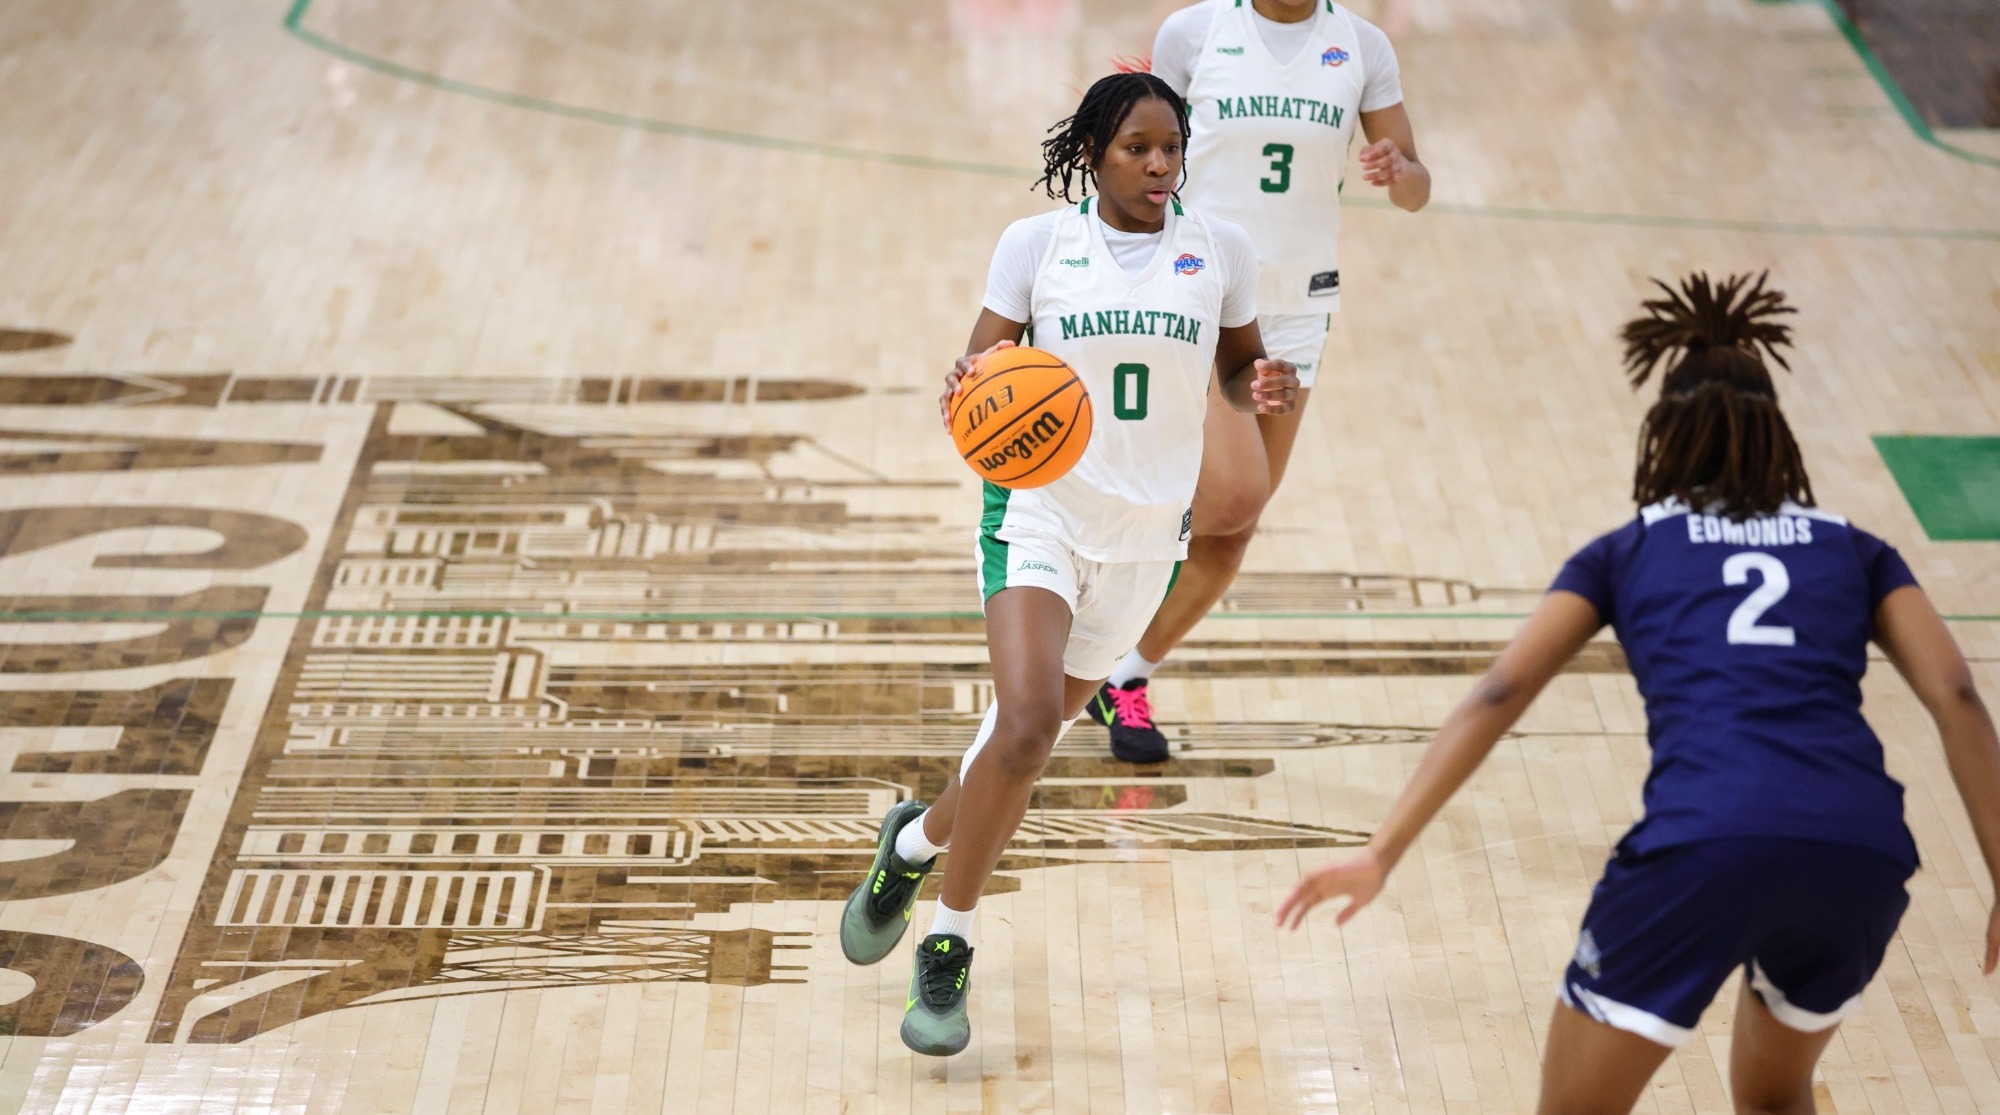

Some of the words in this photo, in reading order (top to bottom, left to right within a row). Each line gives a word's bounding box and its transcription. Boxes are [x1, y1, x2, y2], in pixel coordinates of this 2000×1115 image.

[1216, 95, 1345, 129] MANHATTAN
[1260, 142, 1294, 194] 3
[1059, 256, 1090, 267] capelli
[1173, 257, 1206, 275] MAAC
[1059, 310, 1202, 345] MANHATTAN
[1113, 362, 1150, 421] 0
[977, 410, 1065, 472] Wilson
[1686, 513, 1813, 547] EDMONDS
[1722, 551, 1796, 646] 2
